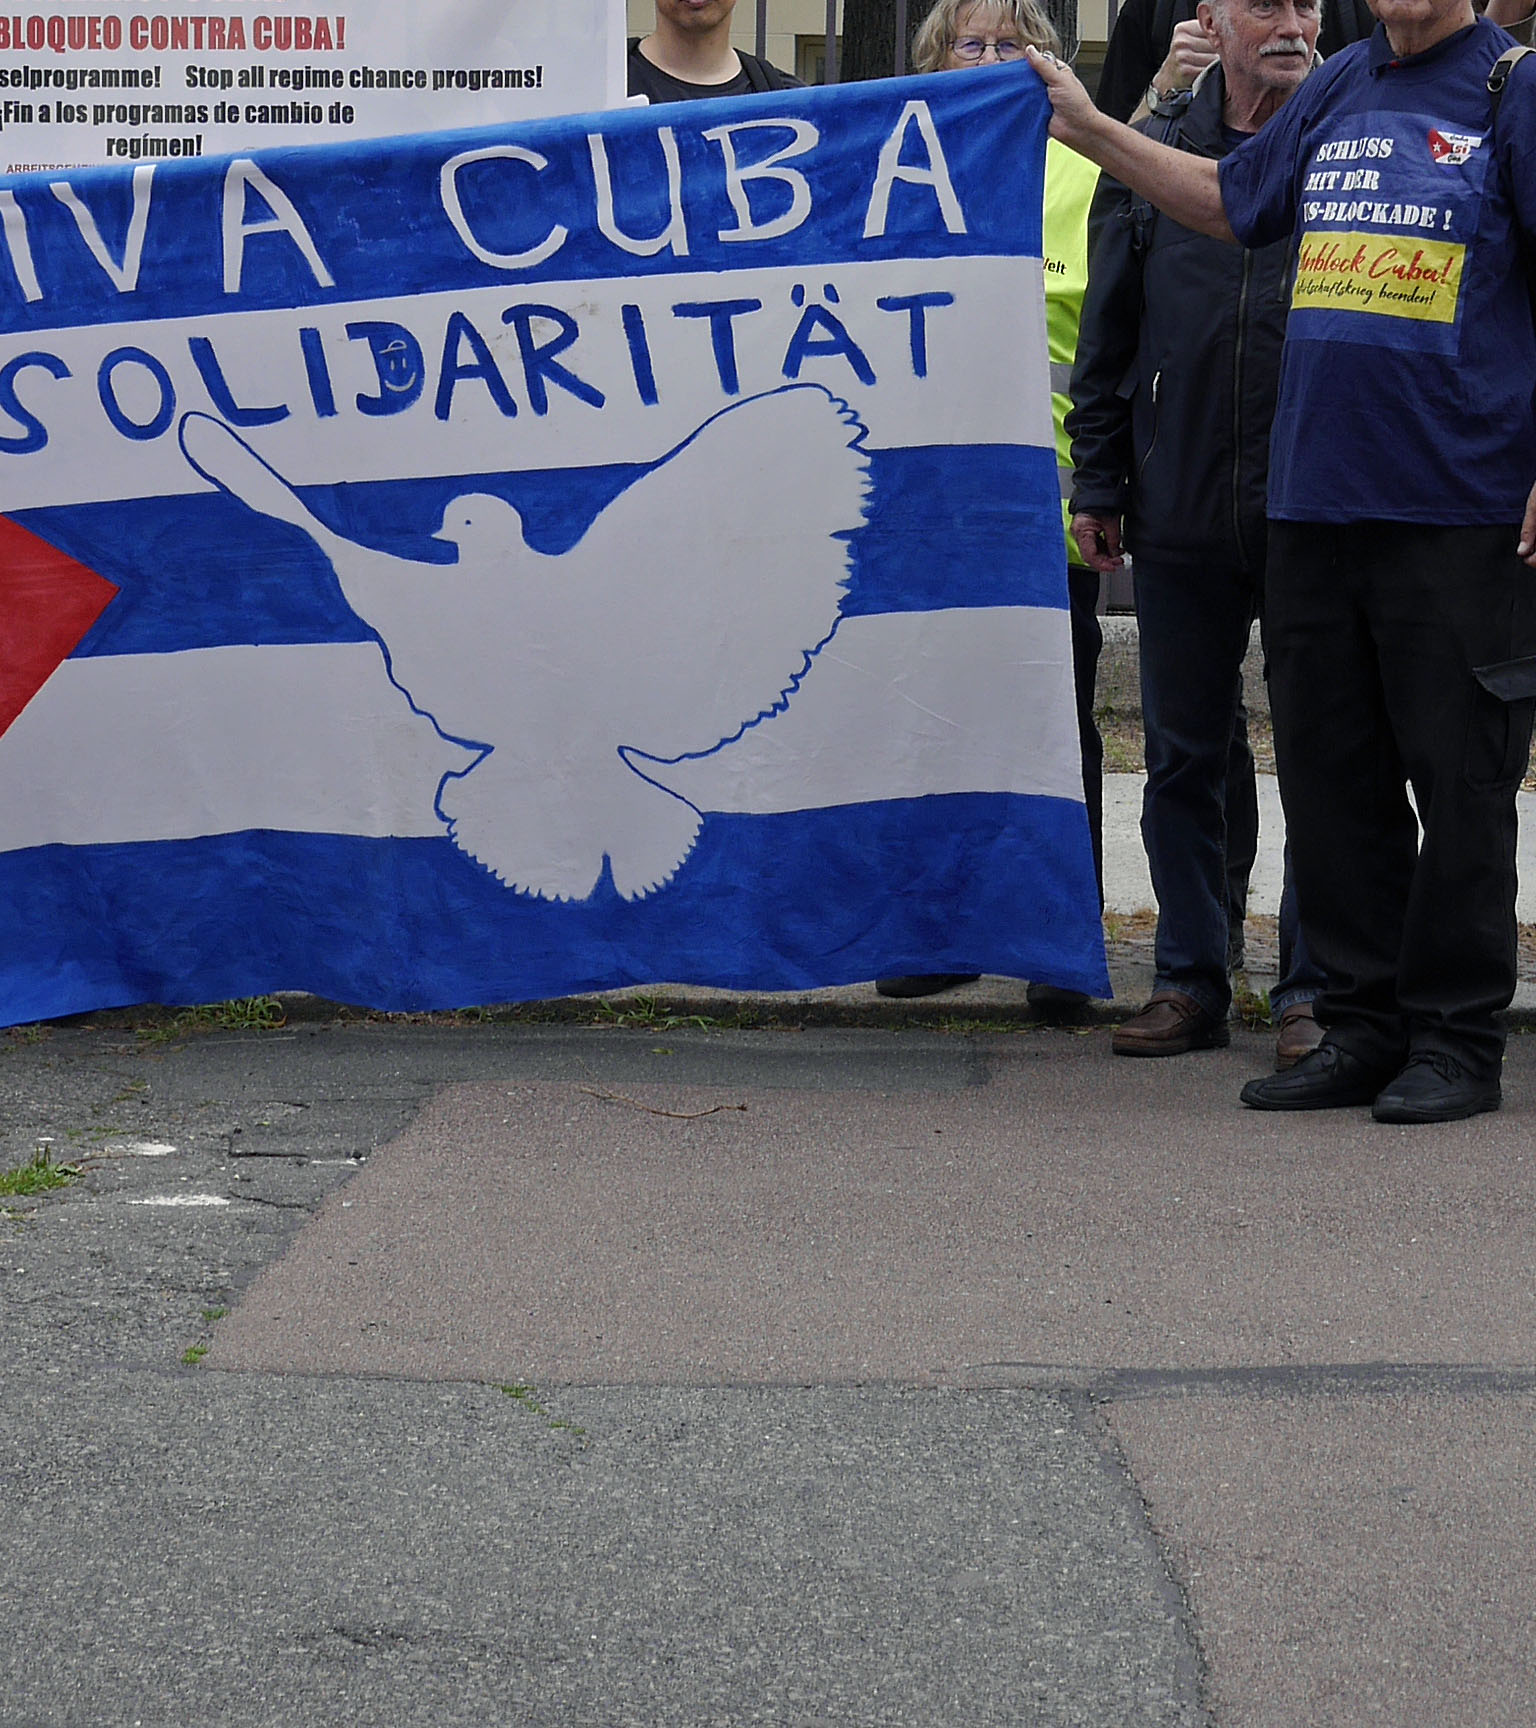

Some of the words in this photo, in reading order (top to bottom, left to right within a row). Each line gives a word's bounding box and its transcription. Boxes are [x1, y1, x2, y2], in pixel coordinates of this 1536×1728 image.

[129, 16, 246, 50] CONTRA
[253, 16, 345, 50] CUBA!
[185, 65, 234, 91] Stop
[237, 65, 264, 88] all
[269, 65, 344, 91] regime
[349, 66, 427, 89] chance
[432, 66, 543, 91] programs!
[37, 107, 52, 125] a
[56, 101, 88, 124] los
[92, 101, 208, 127] programas
[213, 101, 241, 124] de
[244, 101, 324, 124] cambio
[329, 101, 354, 124] de
[106, 134, 202, 160] regímen!
[440, 100, 967, 269] CUBA
[1305, 171, 1340, 191] MIT
[1341, 169, 1380, 191] DER
[1368, 248, 1453, 285] Cuba!
[1379, 283, 1436, 305] beenden!
